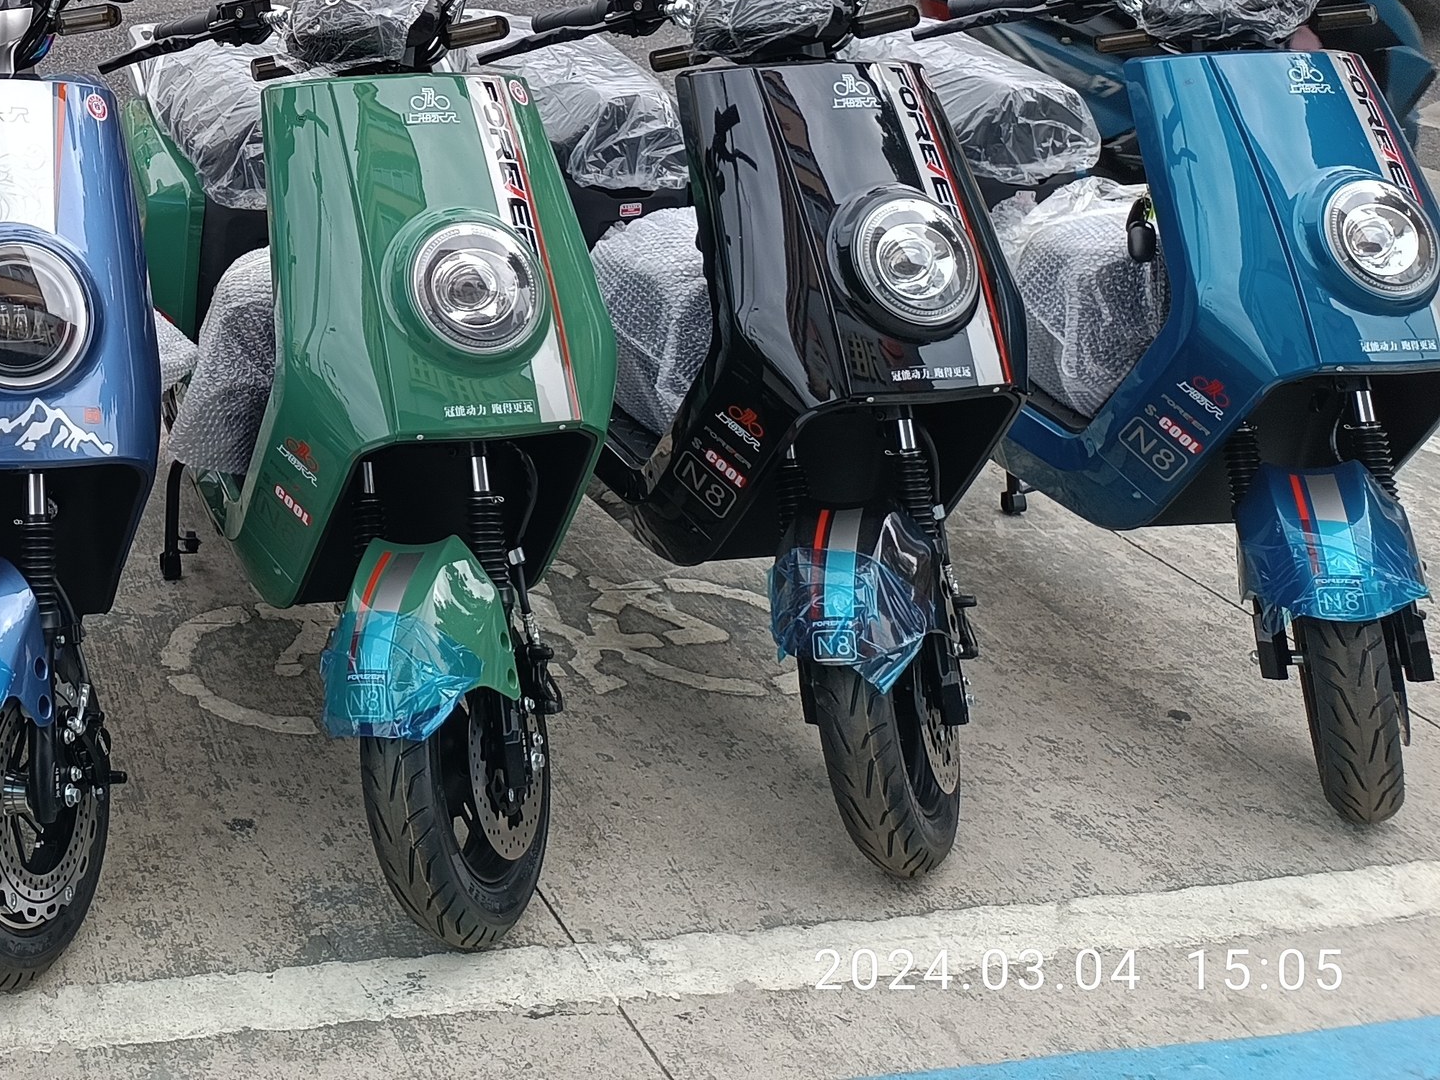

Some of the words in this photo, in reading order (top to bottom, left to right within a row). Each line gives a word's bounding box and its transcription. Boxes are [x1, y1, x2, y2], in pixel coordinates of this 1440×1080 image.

[1127, 425, 1175, 470] N8
[682, 460, 725, 506] N8
[1322, 590, 1360, 612] N8
[817, 635, 851, 656] N8
[350, 689, 379, 711] N8
